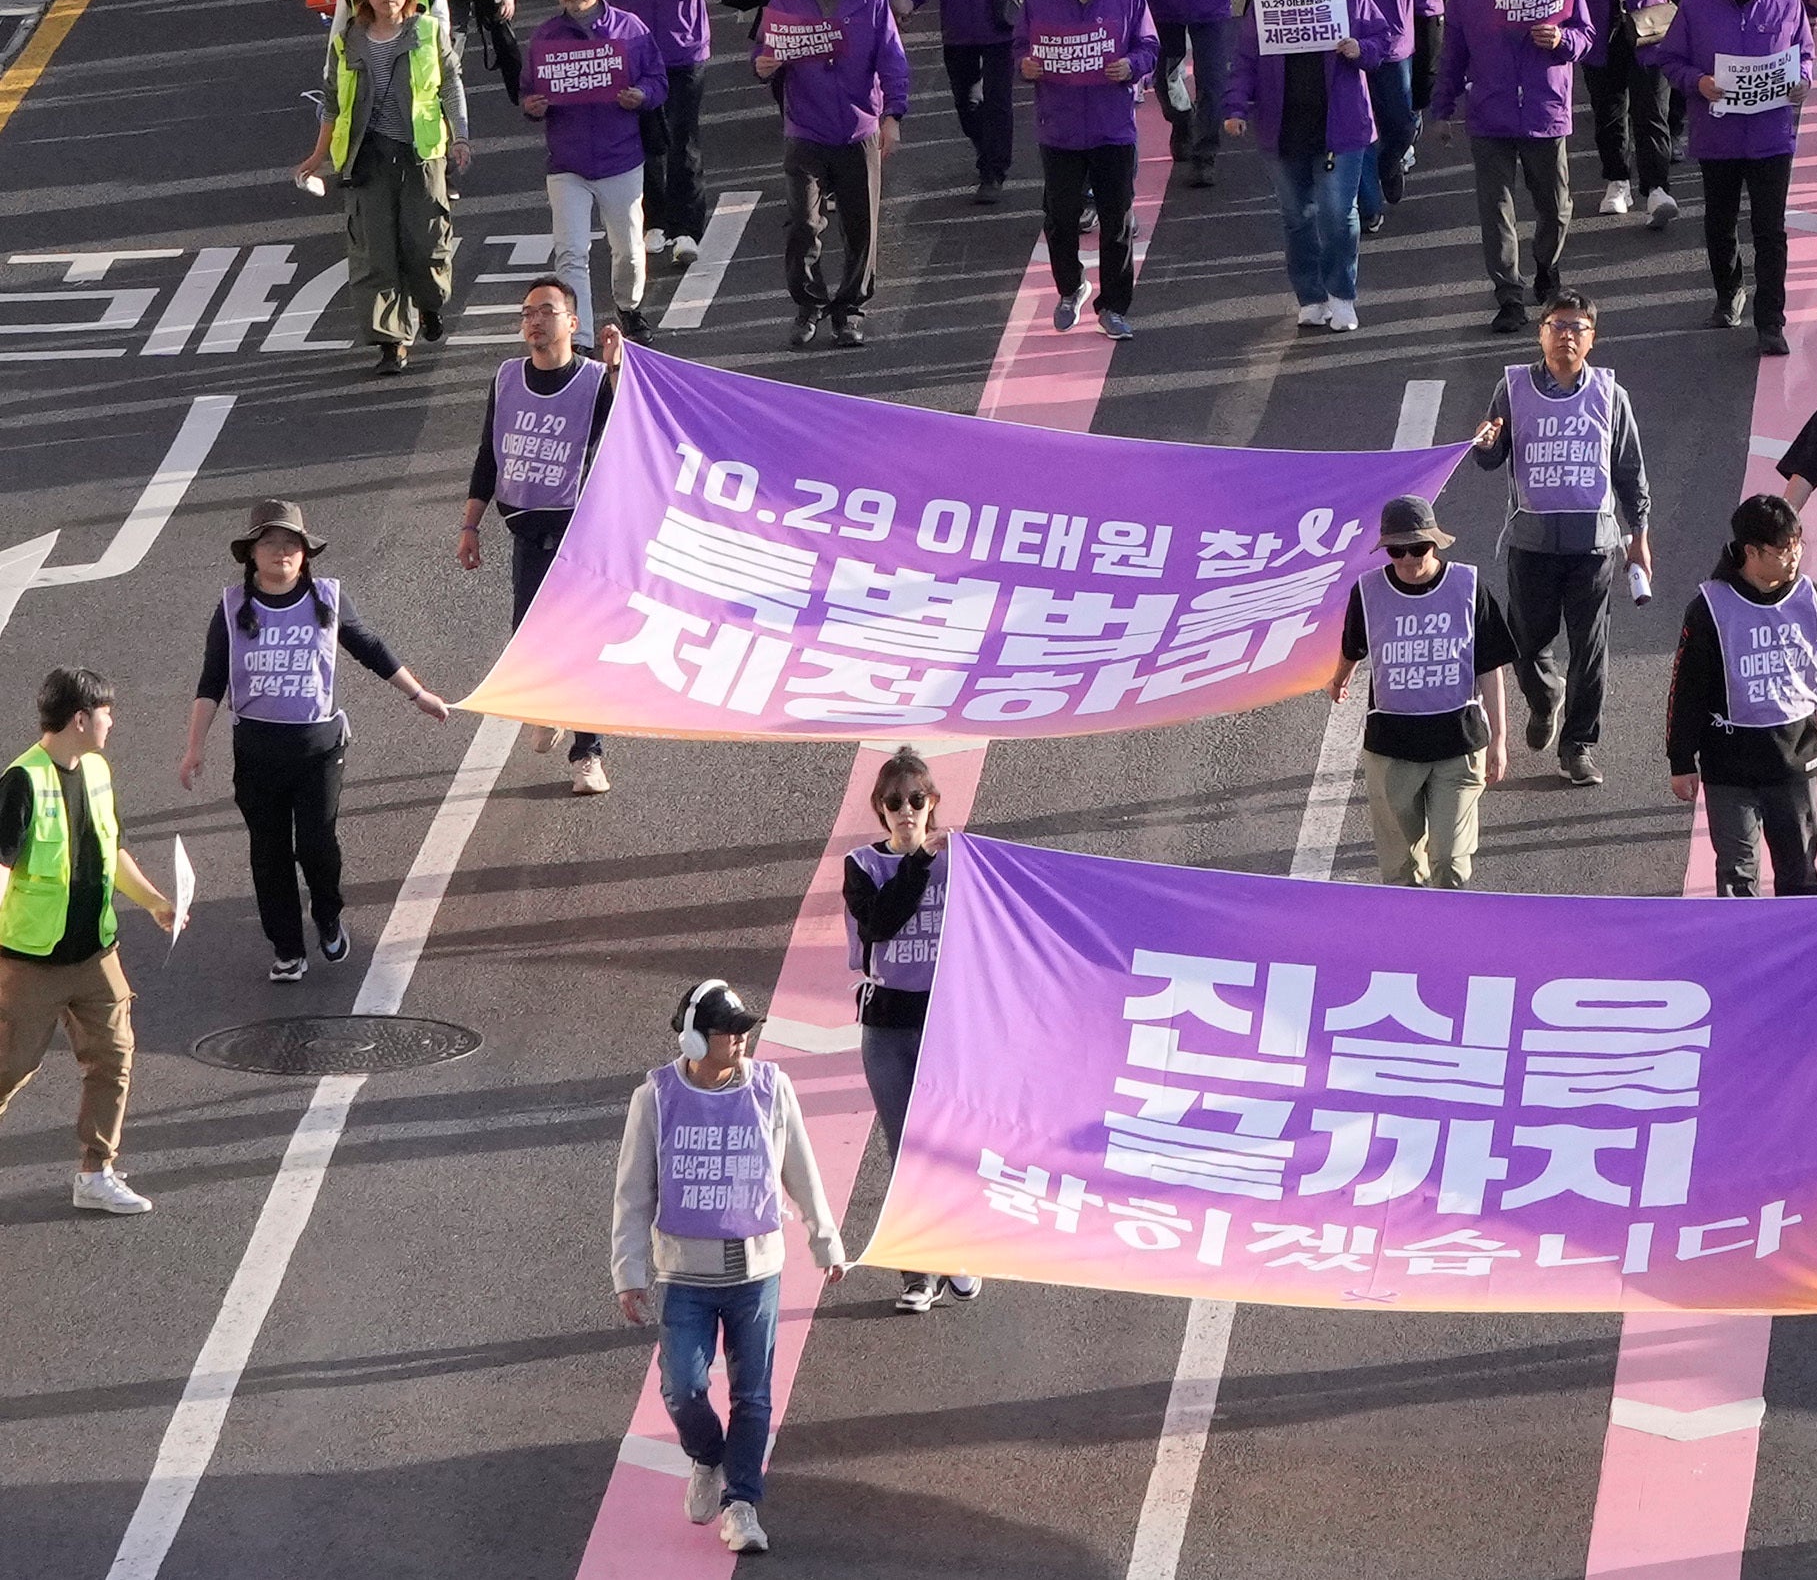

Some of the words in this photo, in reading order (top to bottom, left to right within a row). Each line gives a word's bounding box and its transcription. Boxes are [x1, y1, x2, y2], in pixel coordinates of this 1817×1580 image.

[1261, 0, 1285, 9] 10.29
[1262, 4, 1332, 26] 특별법을
[1040, 33, 1062, 44] 10.29
[1264, 23, 1343, 44] 제정하라!
[545, 52, 568, 62] 10.29
[1032, 37, 1115, 59] 재발방지대책
[536, 56, 623, 80] 재발방지대책
[1043, 55, 1104, 74] 마련하라!
[1727, 64, 1750, 75] 10.29
[550, 74, 612, 94] 마련하라!
[1735, 66, 1787, 88] 진상을
[1724, 81, 1795, 107] 규명하라!
[515, 411, 567, 436] 10.29
[1537, 416, 1591, 438] 10.29
[501, 433, 541, 458] 이태원
[540, 439, 572, 462] 참사
[1524, 441, 1568, 463] 이태원
[1570, 441, 1600, 463] 참사
[503, 458, 563, 487] 진상규명
[1529, 466, 1597, 488] 진상규명
[674, 442, 897, 543] 10.29
[916, 497, 1173, 579] 이태원
[1195, 507, 1365, 580] 참사
[644, 505, 1346, 667] 특별법을
[259, 625, 314, 646] 10.29
[1395, 612, 1451, 637] 10.29
[1749, 622, 1802, 649] 10.29
[244, 650, 289, 671] 이태원
[598, 591, 1320, 725] 제정하라
[1382, 641, 1430, 665] 이태원
[1739, 650, 1785, 678] 이태원
[249, 674, 318, 697] 진상규명
[1387, 664, 1461, 691] 진상규명
[1122, 947, 1712, 1111] 진실을
[673, 1124, 724, 1151] 이태원
[726, 1124, 759, 1151] 참사
[1103, 1076, 1698, 1216] 끝까지
[671, 1155, 722, 1180] 진상규명
[725, 1155, 764, 1179] 특별법
[681, 1184, 759, 1211] 제정하라!
[976, 1147, 1803, 1277] 밝히겠습니다
